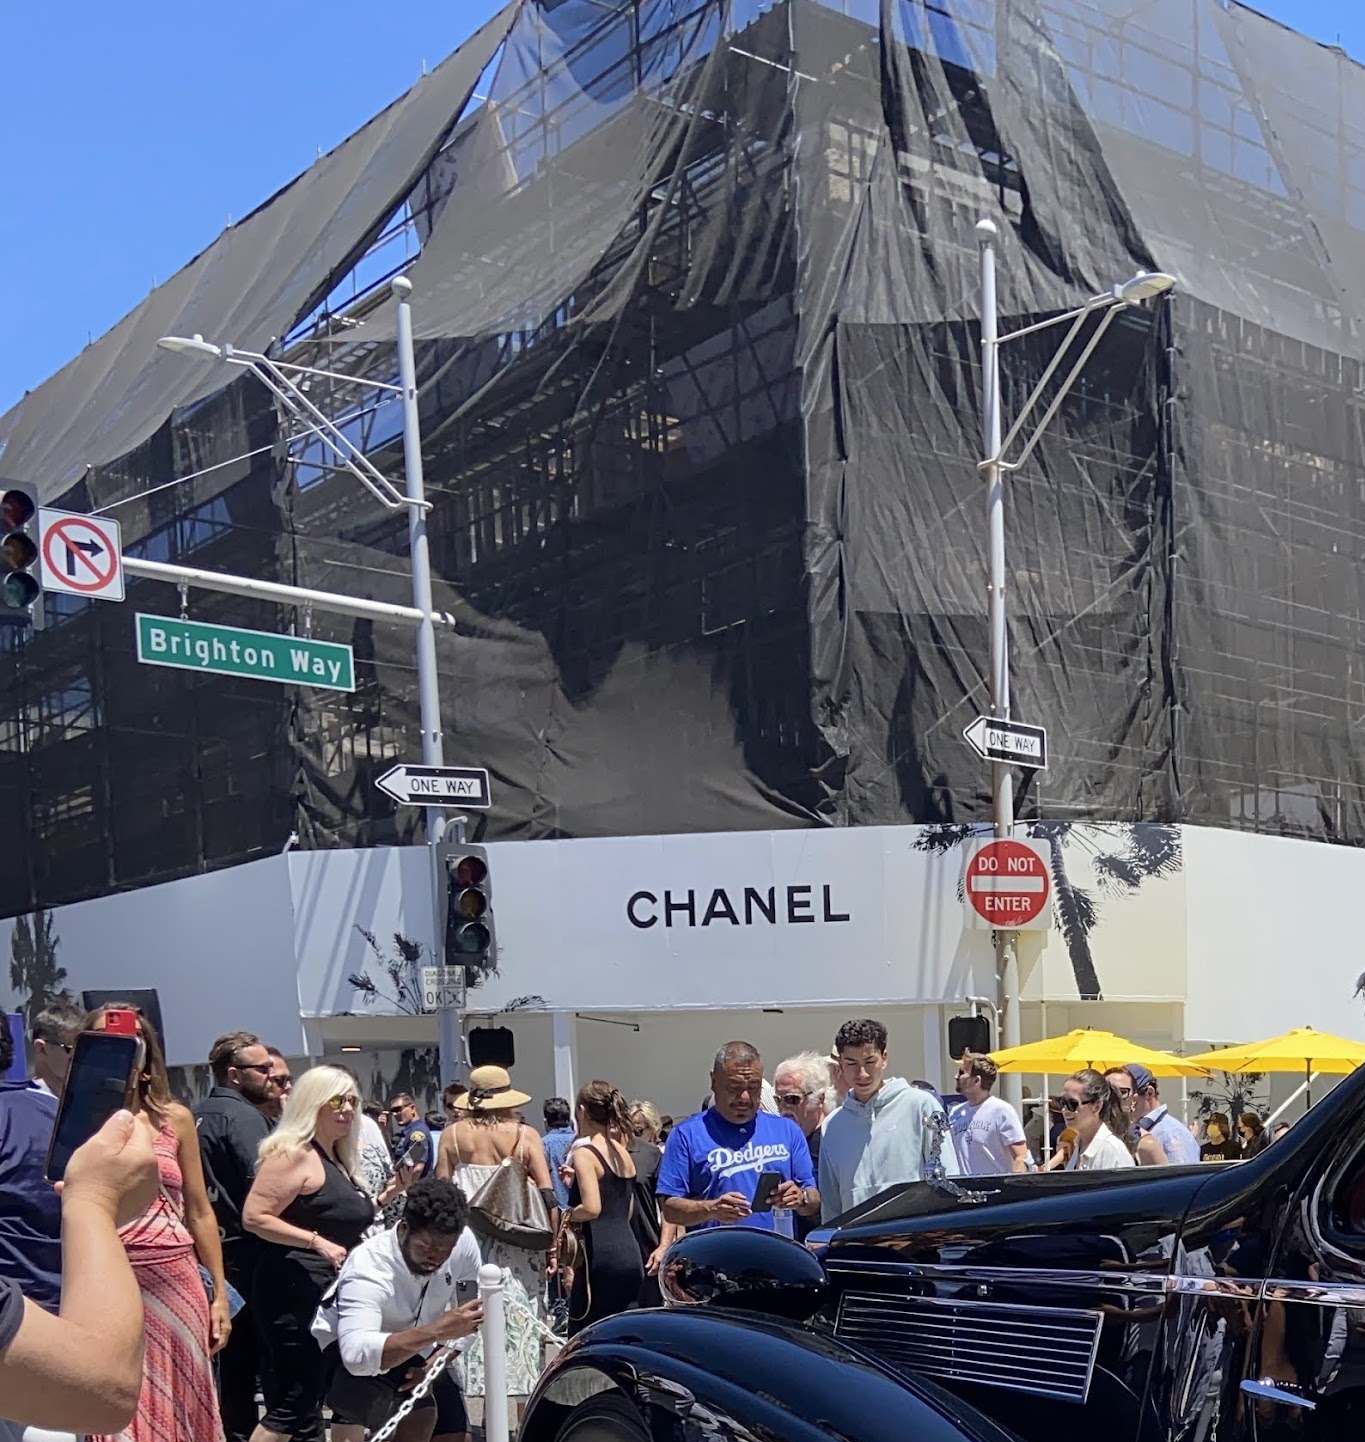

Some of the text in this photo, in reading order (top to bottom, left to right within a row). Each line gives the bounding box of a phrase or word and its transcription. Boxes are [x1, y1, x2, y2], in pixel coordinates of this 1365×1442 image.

[150, 628, 341, 683] Brighton Way
[990, 732, 1035, 753] ONE WAY
[411, 778, 473, 795] ONE WAY
[979, 857, 1035, 872] DO NOT
[627, 885, 850, 929] CHANEL
[985, 897, 1031, 912] ENTER
[426, 991, 443, 1004] OK
[708, 1142, 790, 1173] Dodgers
